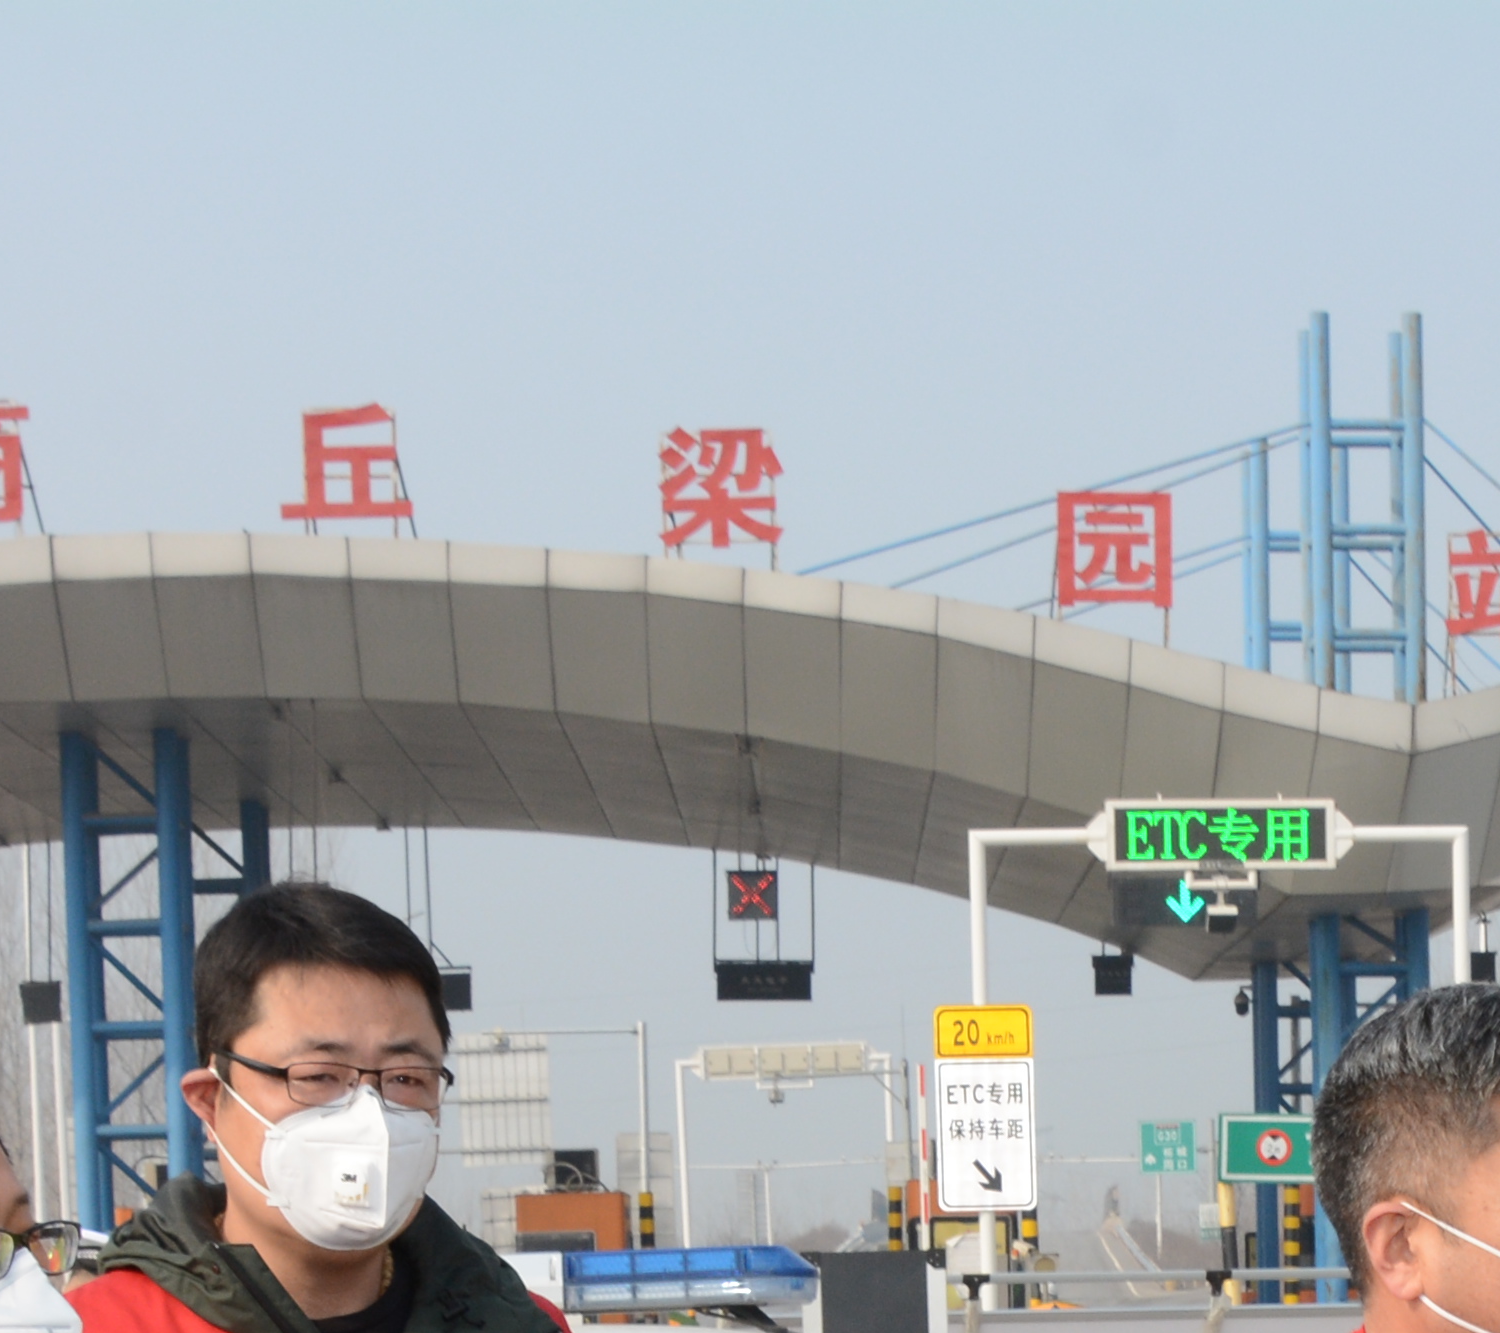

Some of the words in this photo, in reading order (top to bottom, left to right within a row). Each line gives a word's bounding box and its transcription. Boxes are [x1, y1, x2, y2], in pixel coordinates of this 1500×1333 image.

[1125, 806, 1311, 861] ETC专用
[952, 1019, 980, 1046] 20
[986, 1031, 1015, 1046] km/h
[946, 1083, 1023, 1105] ETC专用
[948, 1118, 1023, 1142] 保持车距
